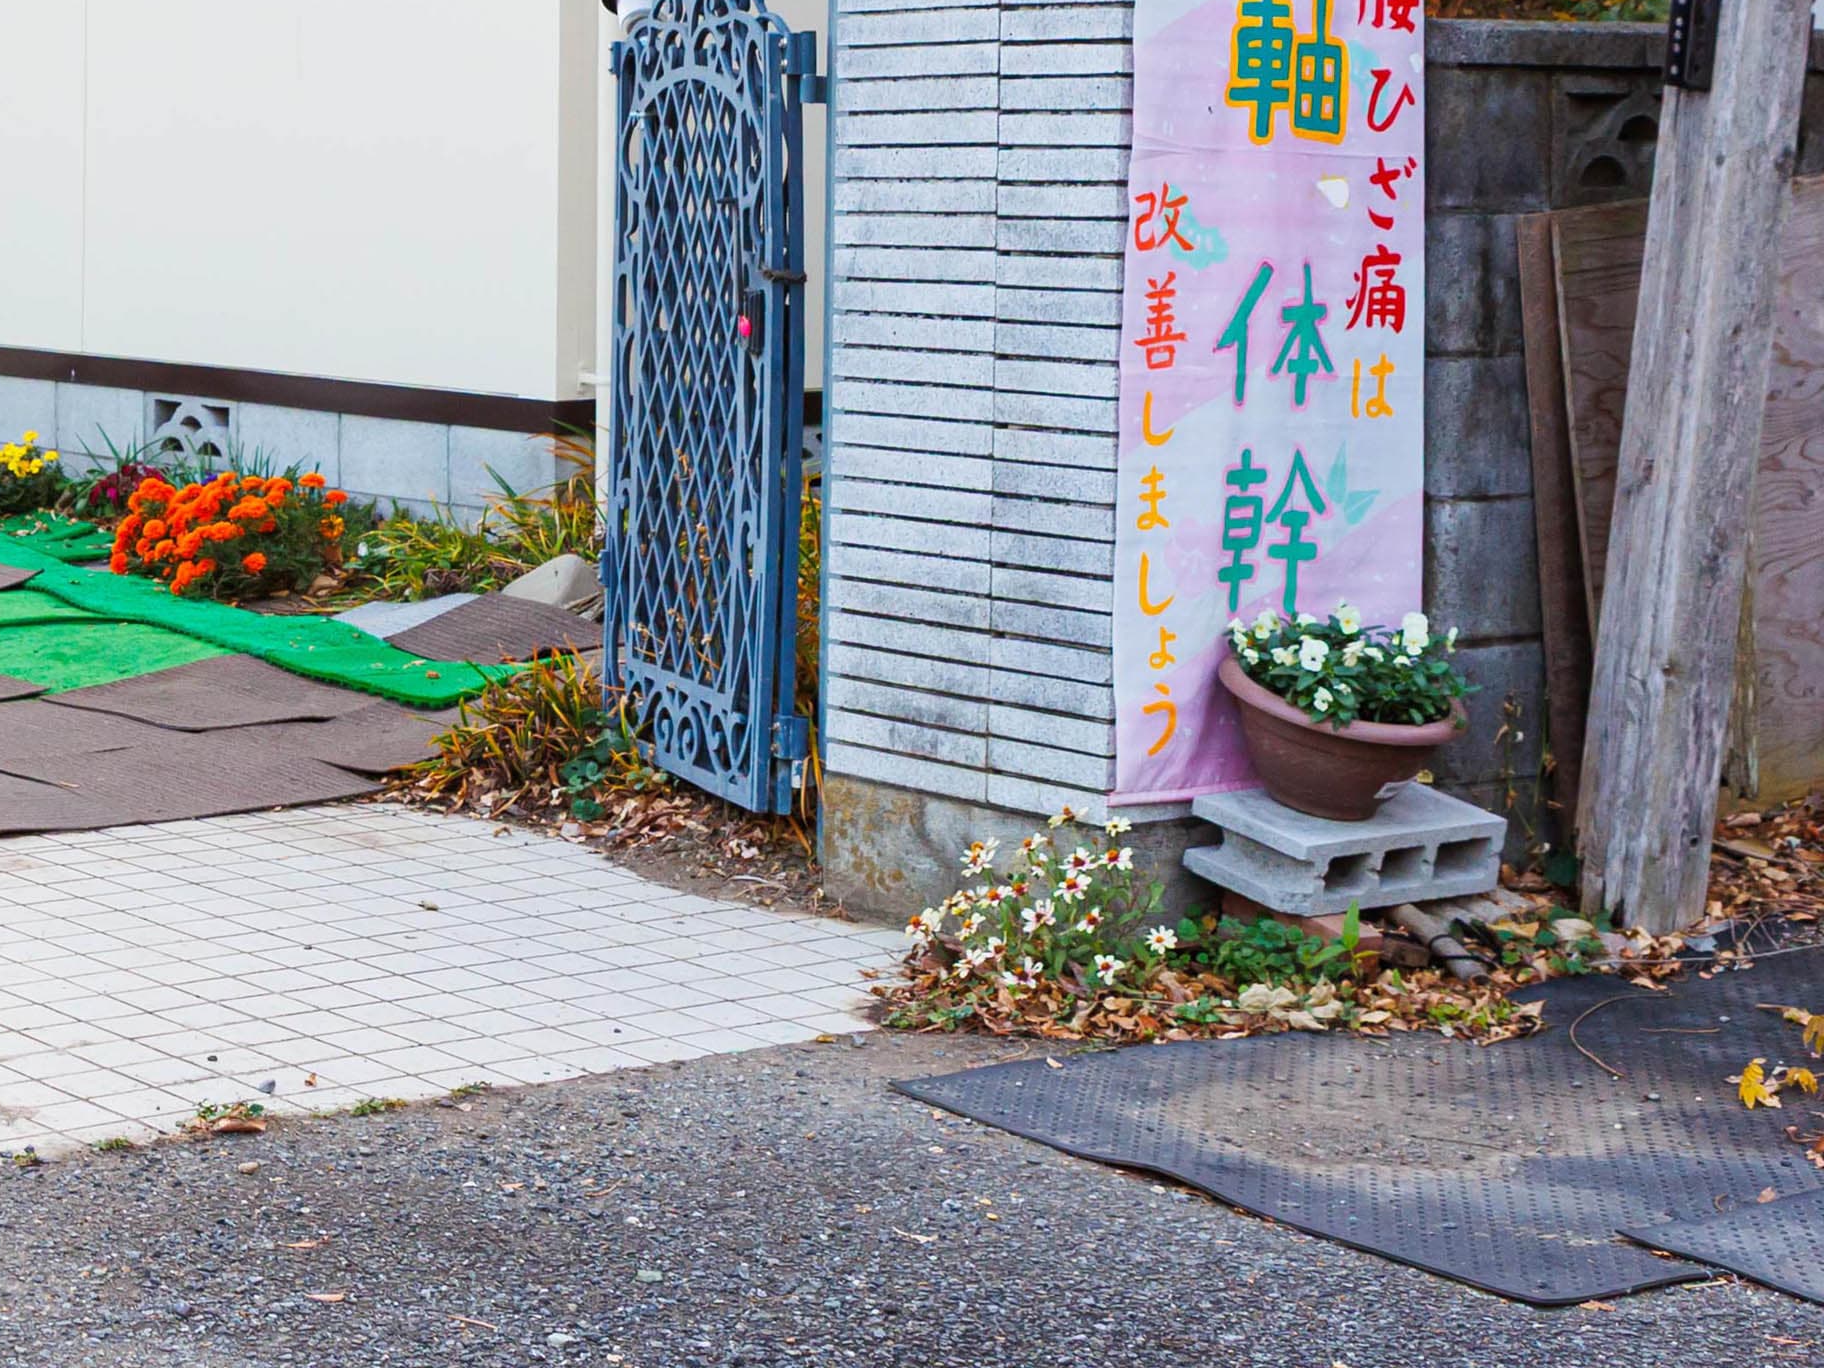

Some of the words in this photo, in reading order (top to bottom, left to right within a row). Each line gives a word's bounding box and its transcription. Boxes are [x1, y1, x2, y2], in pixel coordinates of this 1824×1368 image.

[1133, 182, 1194, 757] 改善しましょう
